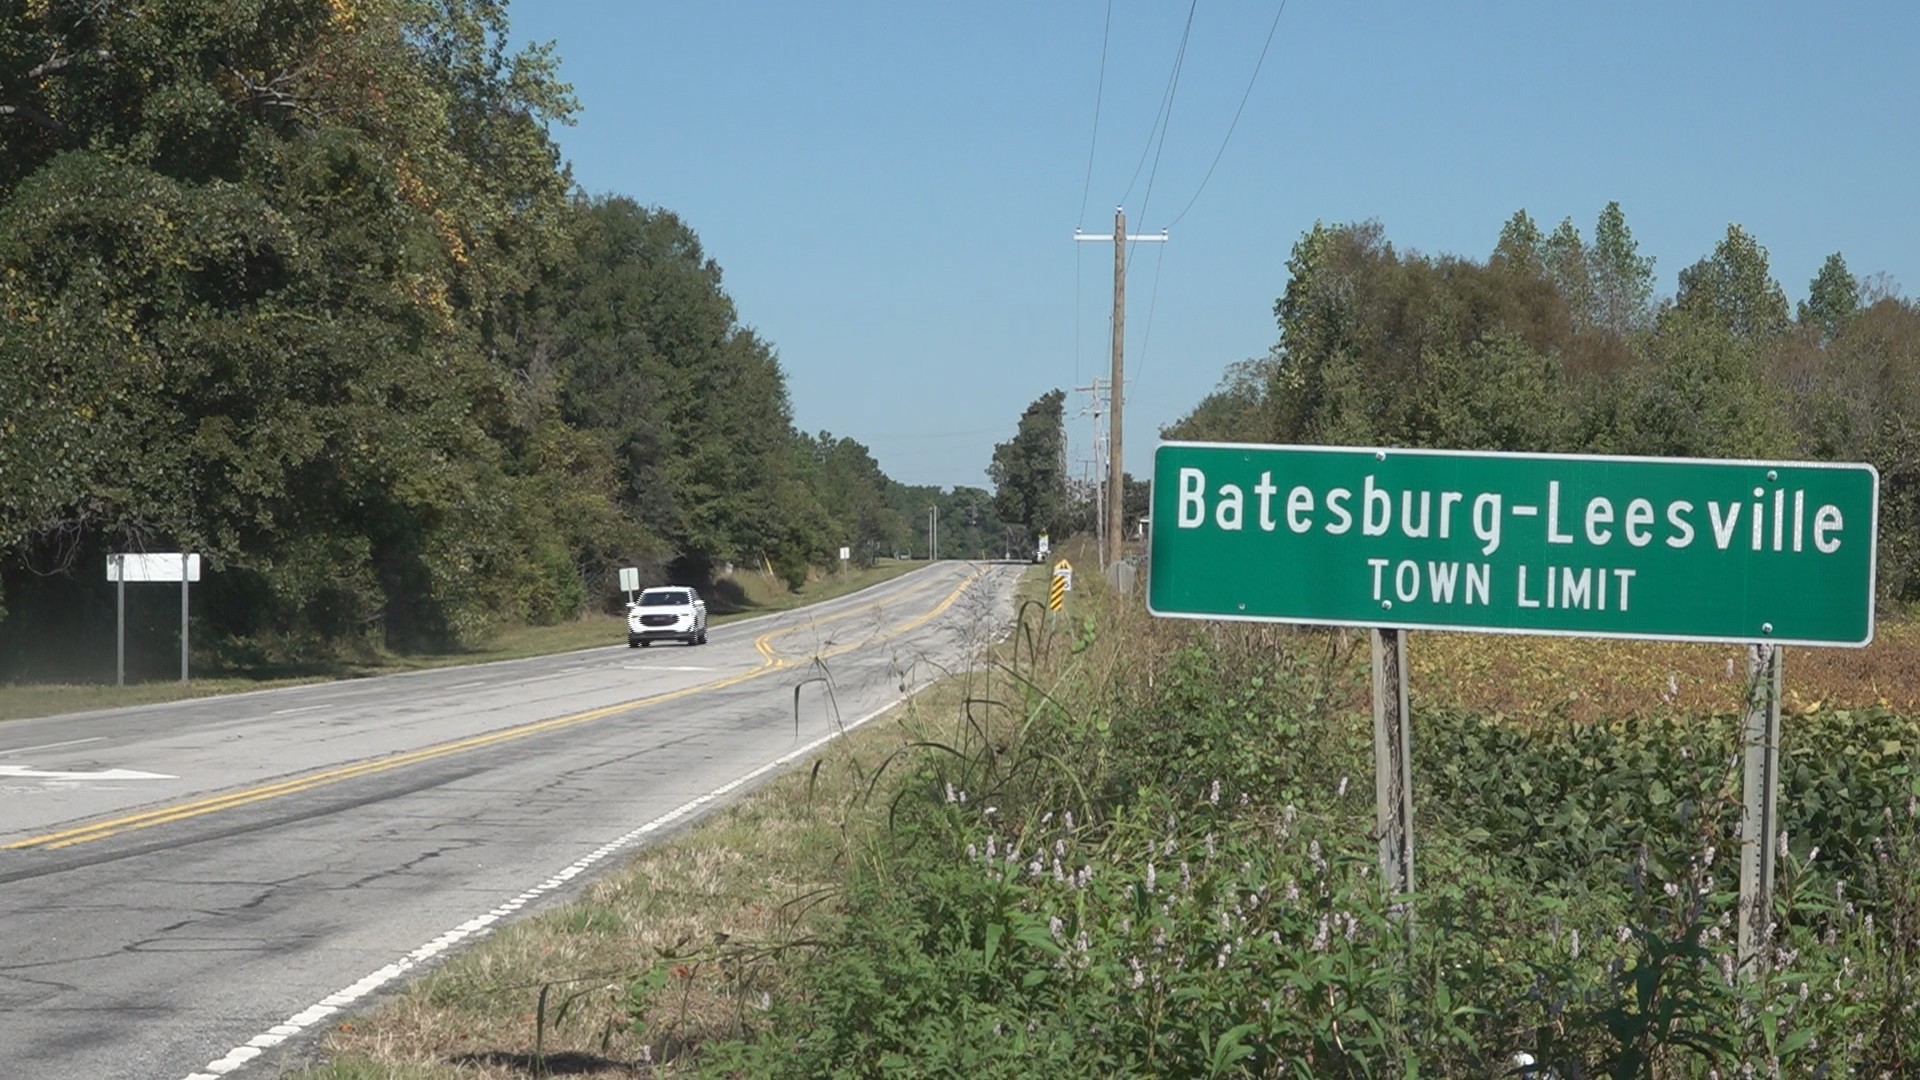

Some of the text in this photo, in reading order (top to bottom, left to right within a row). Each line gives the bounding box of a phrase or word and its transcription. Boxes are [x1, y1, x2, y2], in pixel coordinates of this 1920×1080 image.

[1178, 467, 1843, 556] Batesburg-Leesville
[1367, 558, 1636, 611] TOWN LIMIT
